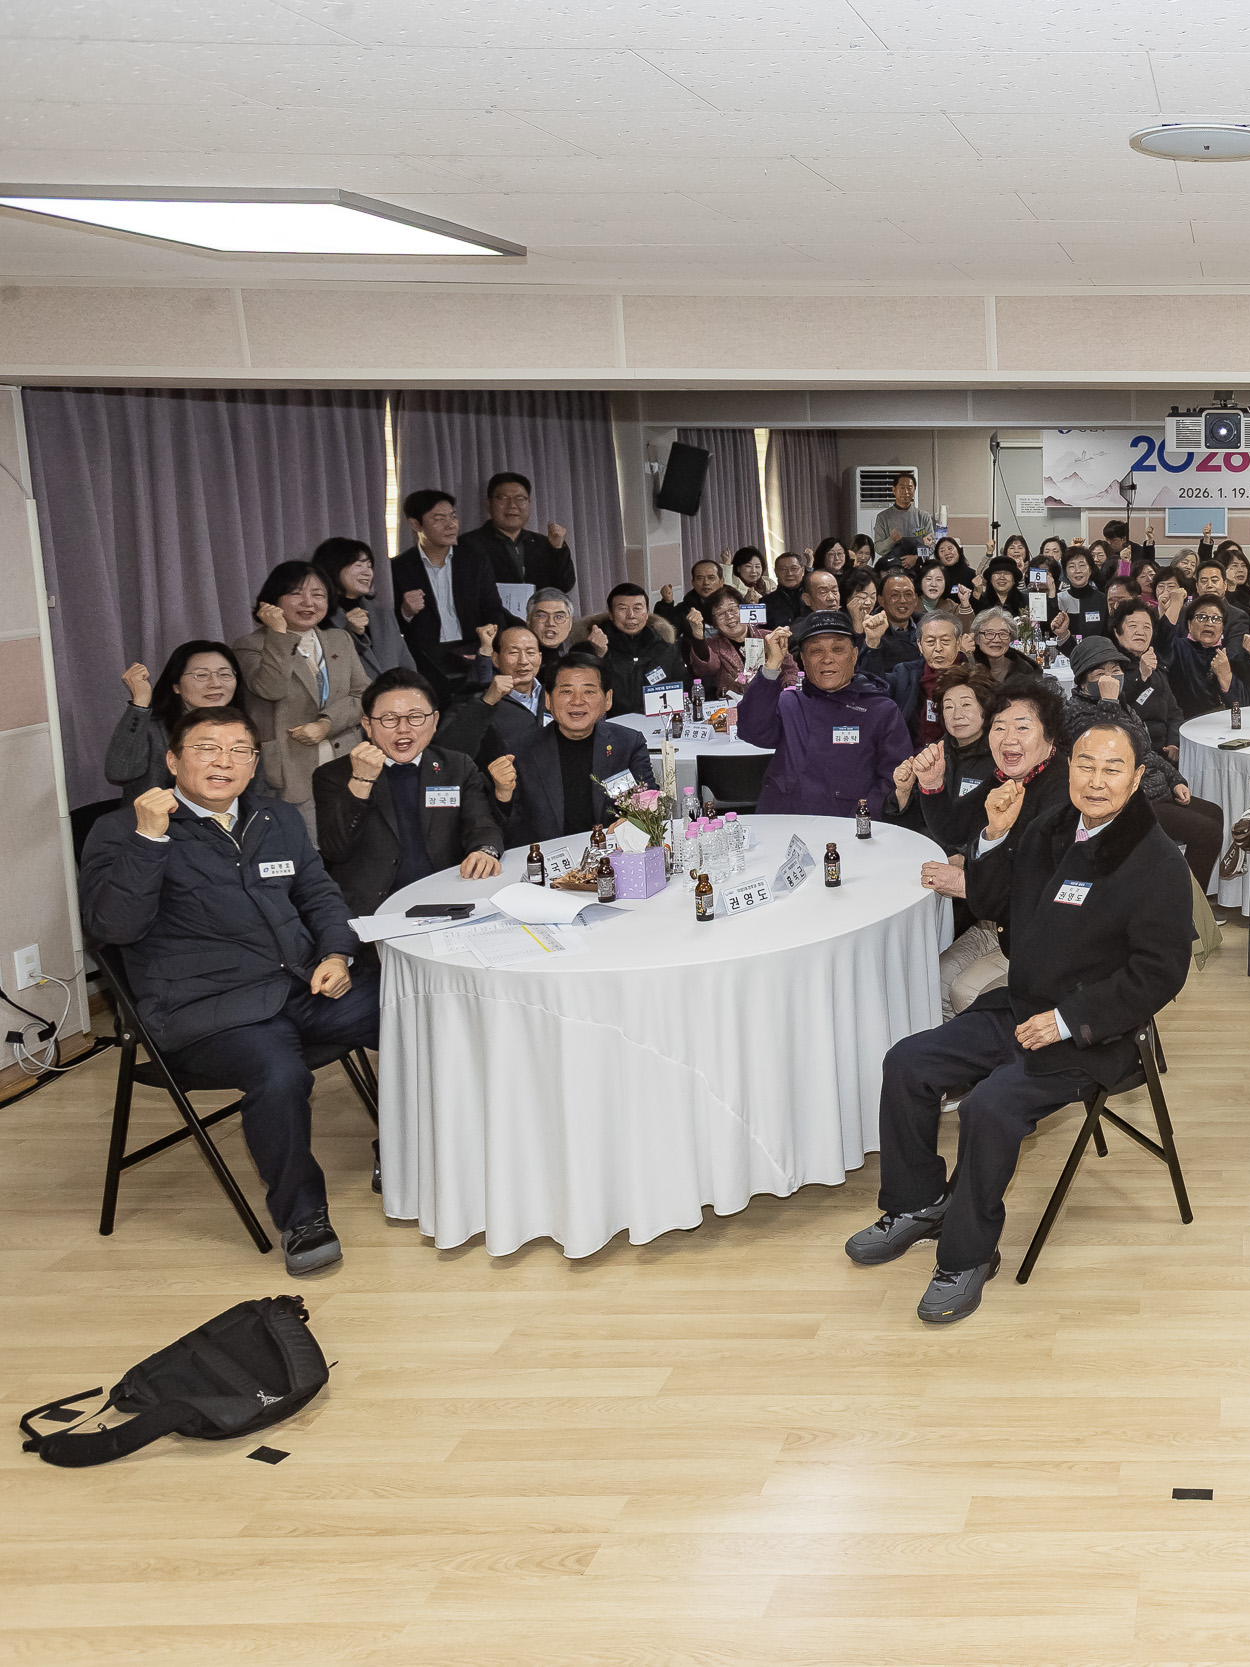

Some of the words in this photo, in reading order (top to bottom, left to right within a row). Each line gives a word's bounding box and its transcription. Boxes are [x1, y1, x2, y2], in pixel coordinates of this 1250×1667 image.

[1178, 487, 1213, 499] 2026.
[1035, 572, 1041, 581] 6
[750, 610, 757, 621] 5
[659, 692, 667, 709] 1
[428, 797, 457, 806] 장국환
[729, 888, 768, 910] 권영도
